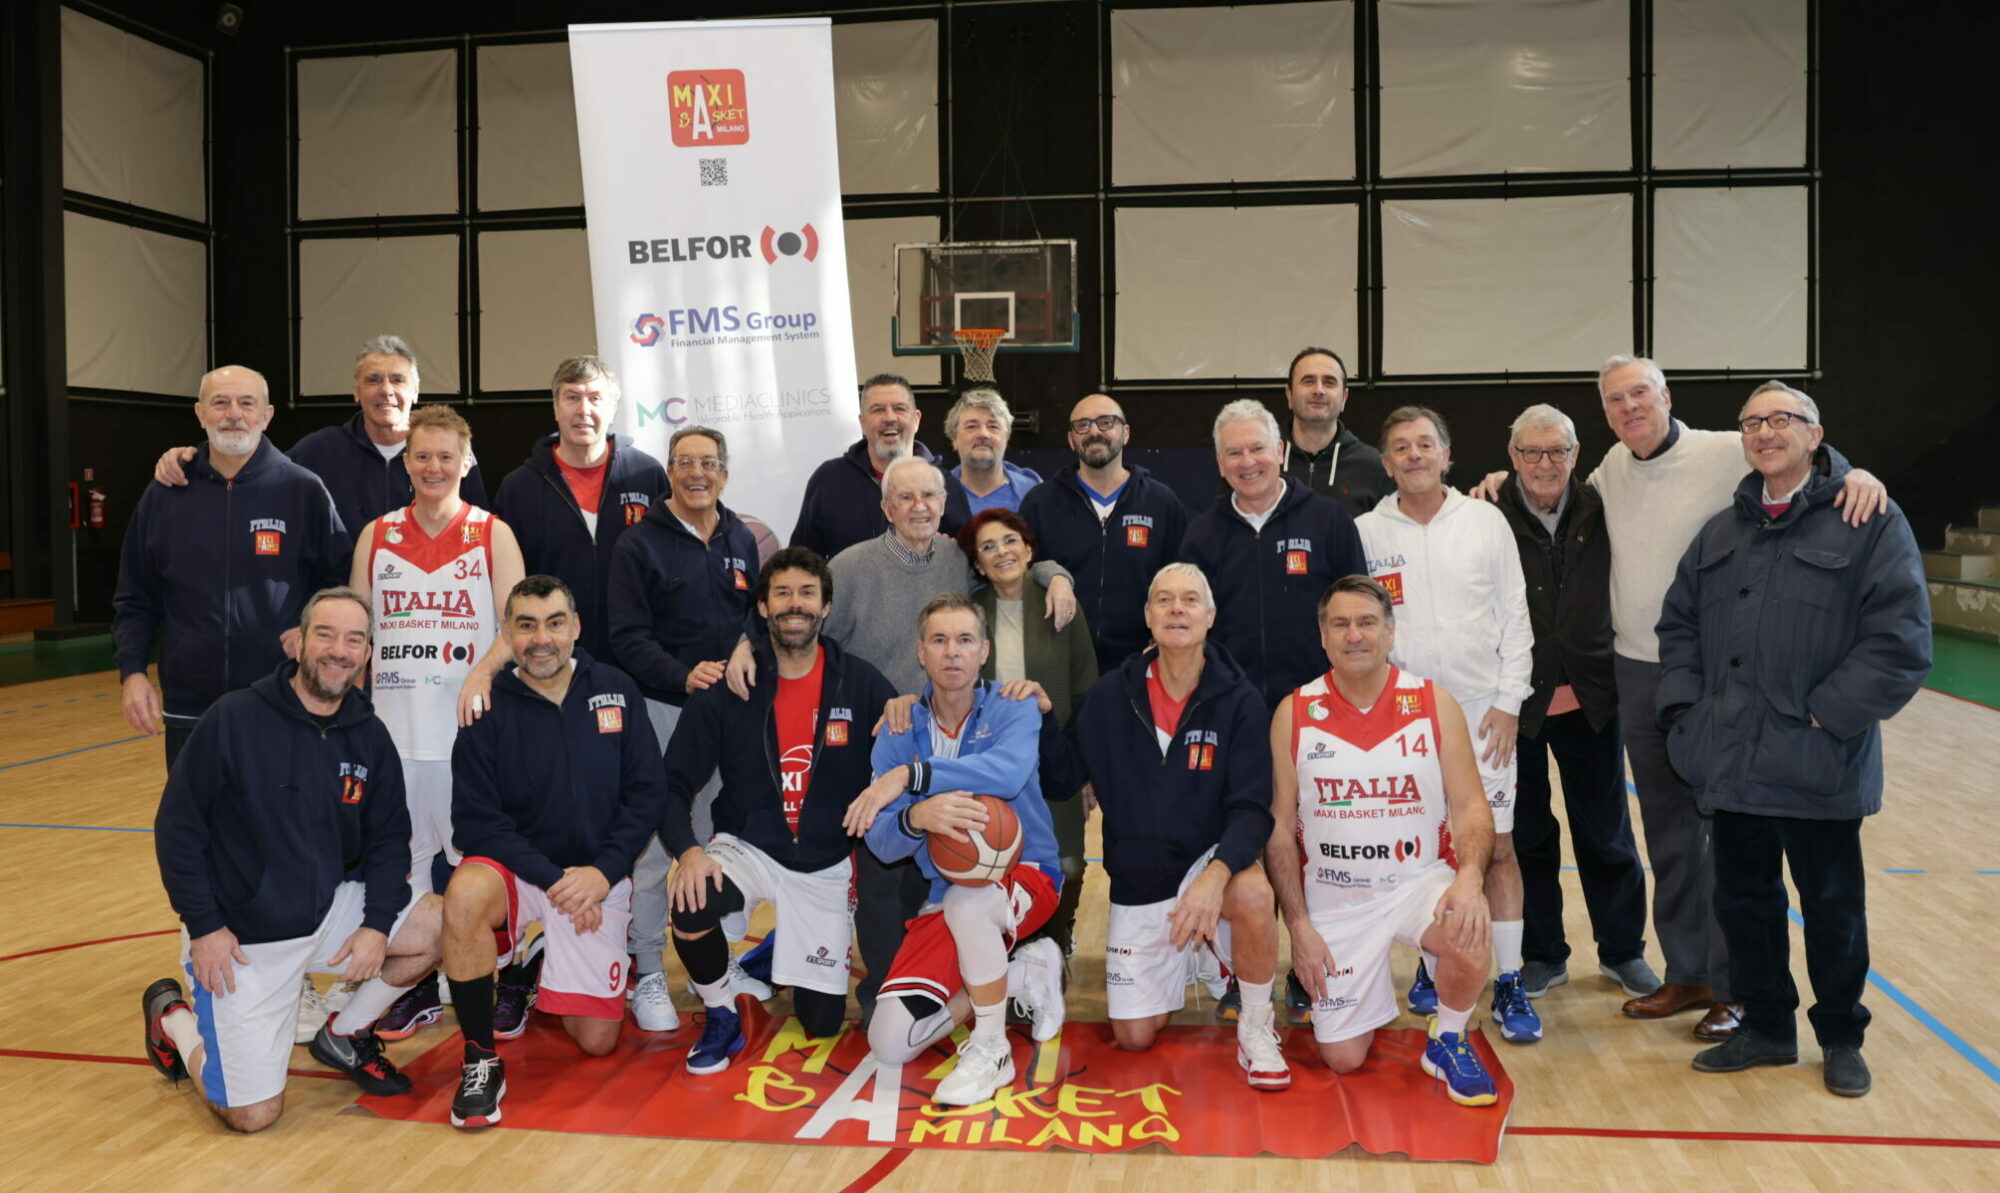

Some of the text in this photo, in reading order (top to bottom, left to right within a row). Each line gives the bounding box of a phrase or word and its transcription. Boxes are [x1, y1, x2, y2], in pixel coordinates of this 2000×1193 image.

[717, 125, 745, 133] MILANO
[628, 235, 752, 264] BELFOR
[669, 306, 816, 335] FMS Group
[671, 331, 820, 348] Financial Management System
[694, 388, 831, 412] MEDIACLINICS
[695, 413, 741, 424] Wearable
[454, 559, 482, 580] 34
[382, 590, 476, 617] ITALIA
[380, 620, 479, 631] MAXI BASKET MILANO
[381, 644, 438, 660] BELFOR
[1396, 733, 1428, 757] 14
[1314, 774, 1422, 804] ITALIA
[1314, 806, 1425, 819] MAXI BASKET MILANO
[1319, 843, 1390, 860] BELFOR
[1324, 868, 1351, 884] FMS
[609, 961, 620, 992] 9
[909, 1114, 1180, 1147] MILANO
